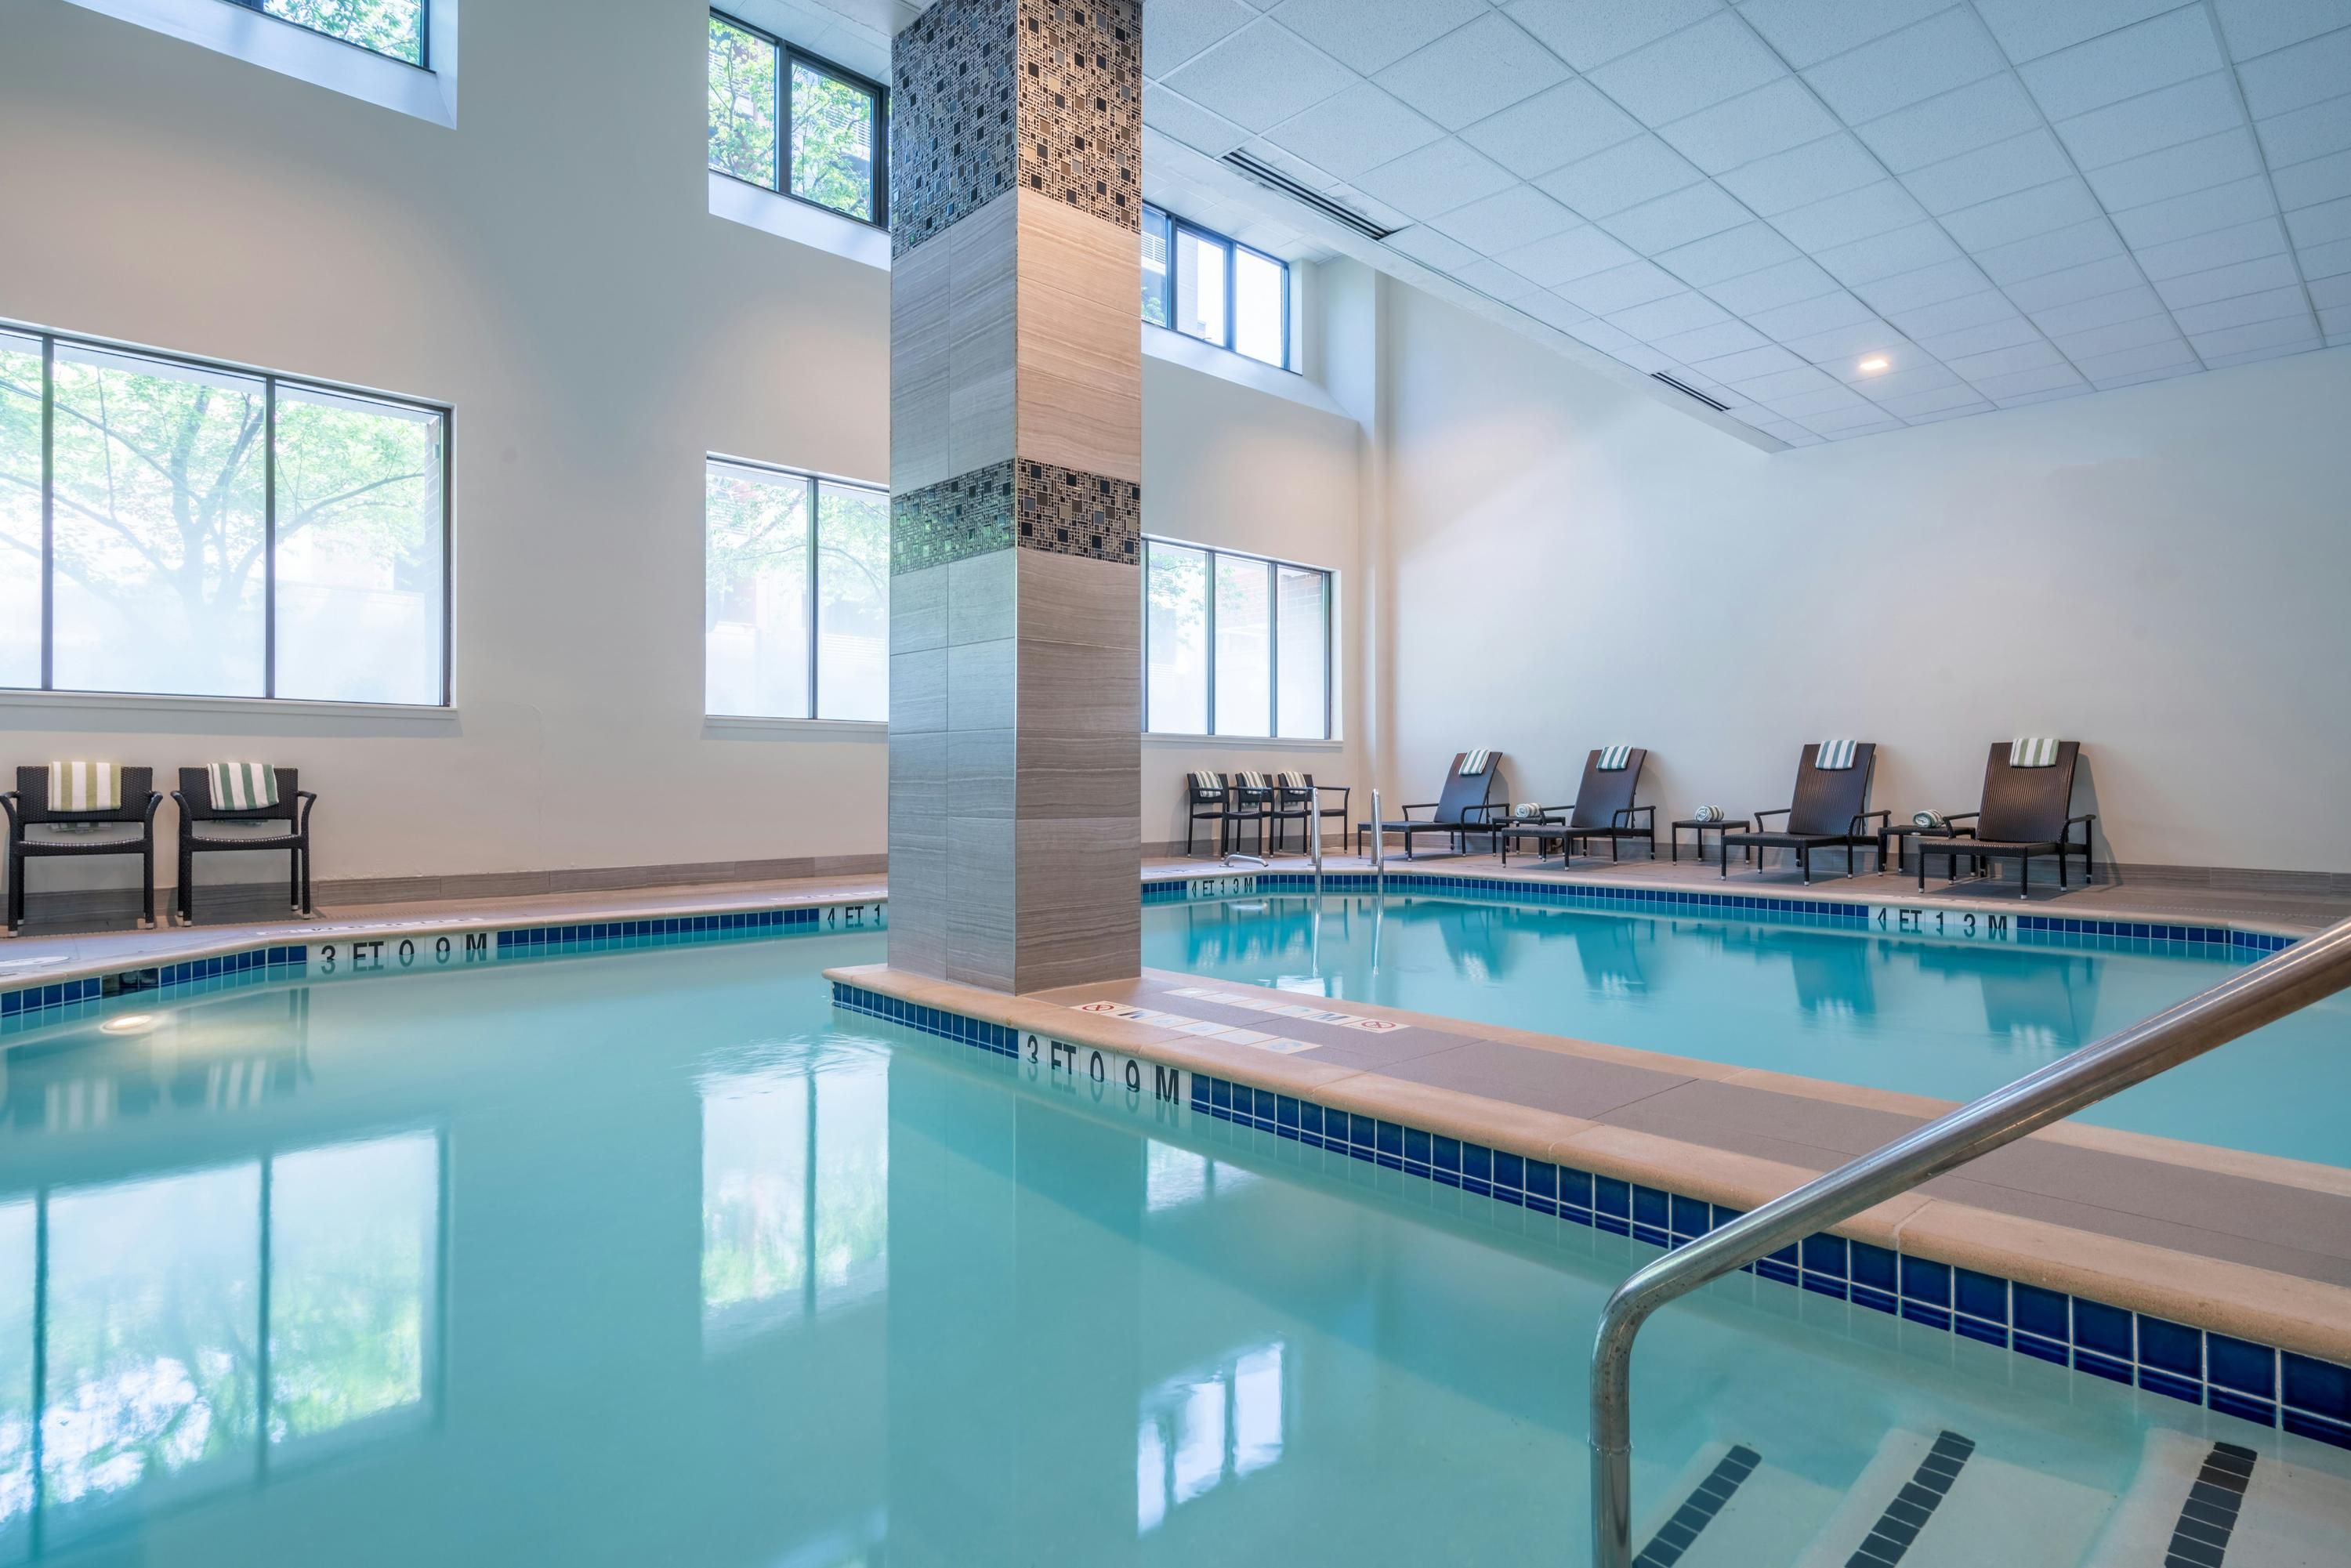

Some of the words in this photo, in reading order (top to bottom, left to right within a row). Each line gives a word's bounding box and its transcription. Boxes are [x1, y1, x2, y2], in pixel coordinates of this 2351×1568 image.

[845, 905, 864, 919] FT
[1899, 908, 1922, 924] FT
[1936, 911, 1943, 925] 1
[1987, 914, 2008, 930] M
[321, 945, 336, 961] 3
[353, 941, 384, 960] FT
[465, 932, 487, 951] M
[1027, 1034, 1038, 1064] 3
[1050, 1040, 1077, 1075] FT
[1089, 1050, 1105, 1083] 0
[1125, 1059, 1141, 1093] 9
[1155, 1064, 1179, 1106] M
